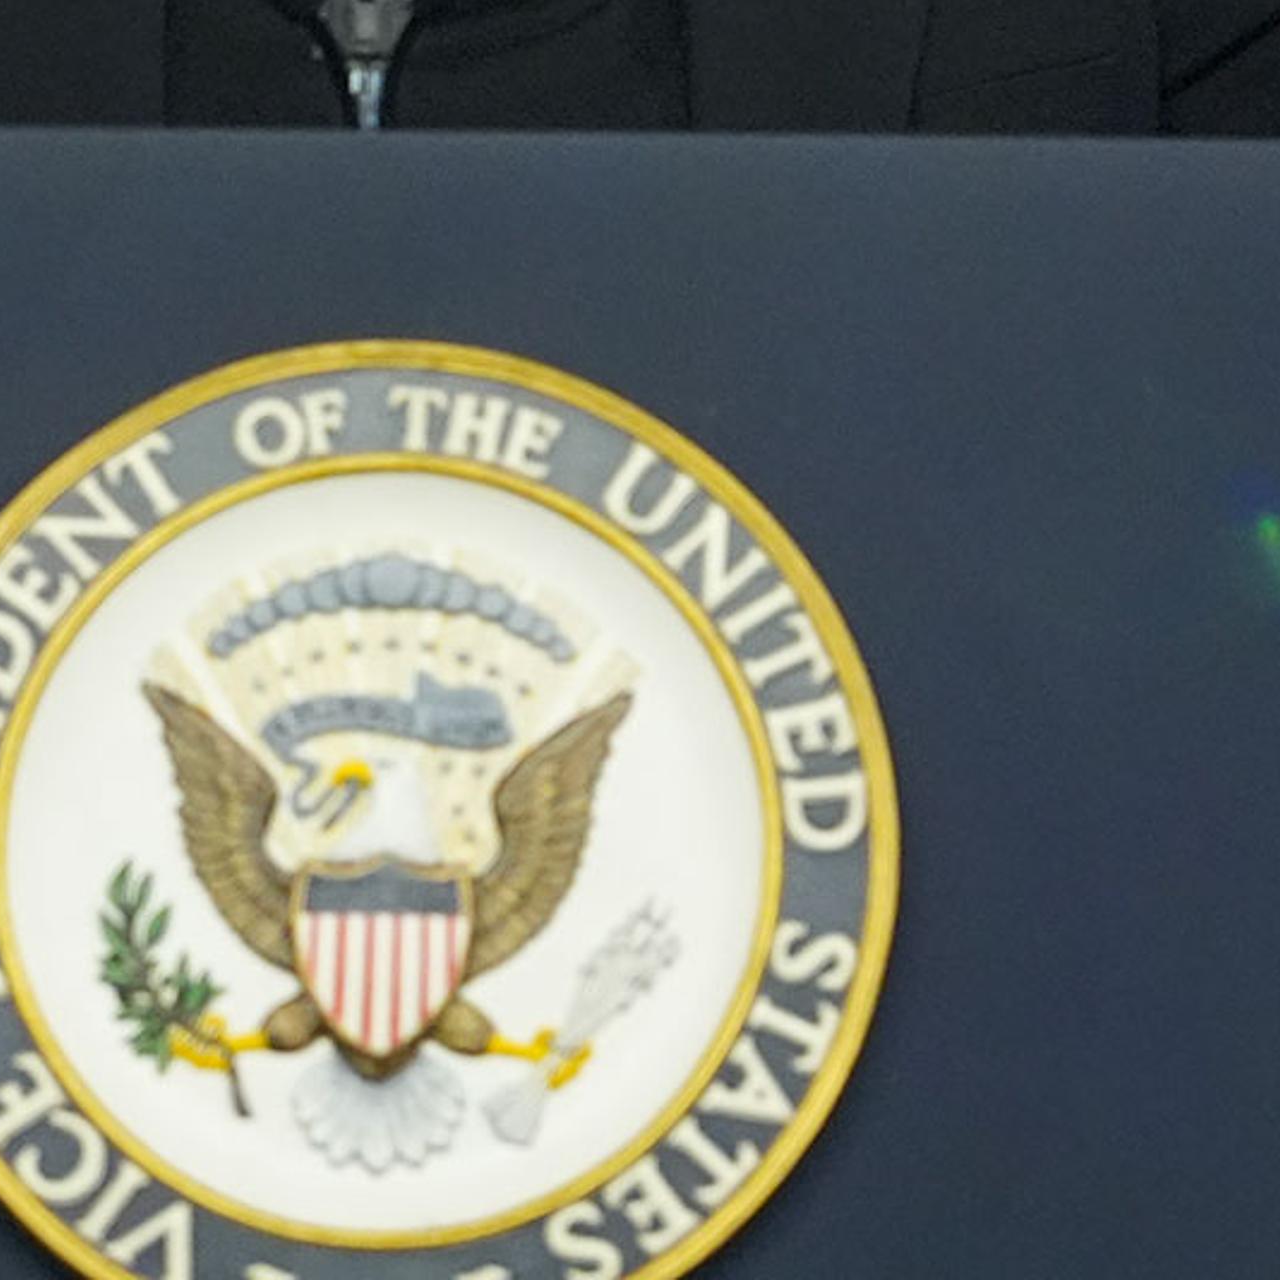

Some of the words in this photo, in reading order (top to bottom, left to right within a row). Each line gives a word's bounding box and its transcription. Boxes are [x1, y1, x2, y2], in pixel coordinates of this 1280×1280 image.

[232, 386, 348, 470] OF
[386, 383, 564, 481] THE
[602, 440, 869, 852] UNITED
[542, 918, 860, 1280] STATES
